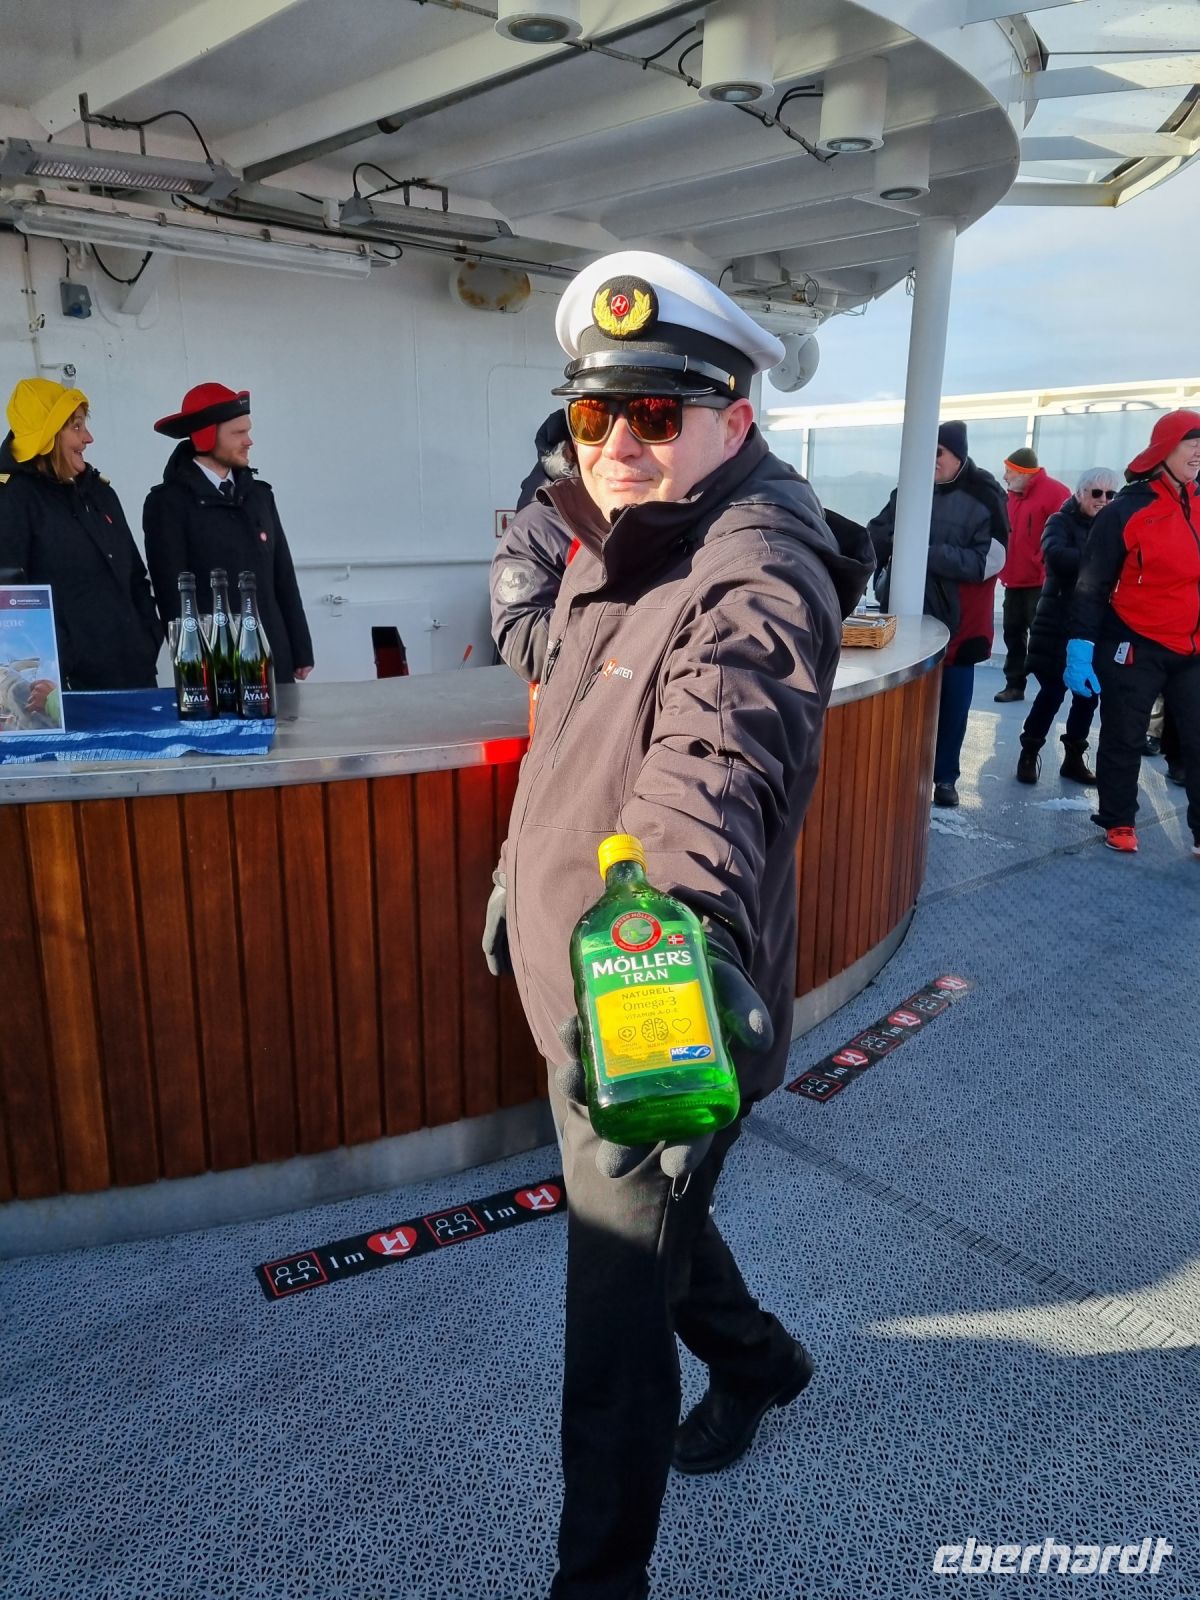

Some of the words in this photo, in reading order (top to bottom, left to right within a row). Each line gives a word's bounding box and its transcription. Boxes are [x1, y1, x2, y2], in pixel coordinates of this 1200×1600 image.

[0, 619, 25, 629] gne
[182, 691, 210, 702] AYALA
[244, 689, 270, 701] AYALA
[621, 968, 669, 985] TRAN
[621, 986, 675, 1000] NATURELL
[623, 996, 677, 1011] Omega-3
[671, 1047, 690, 1056] MSC
[497, 1205, 516, 1219] m
[344, 1252, 364, 1266] m
